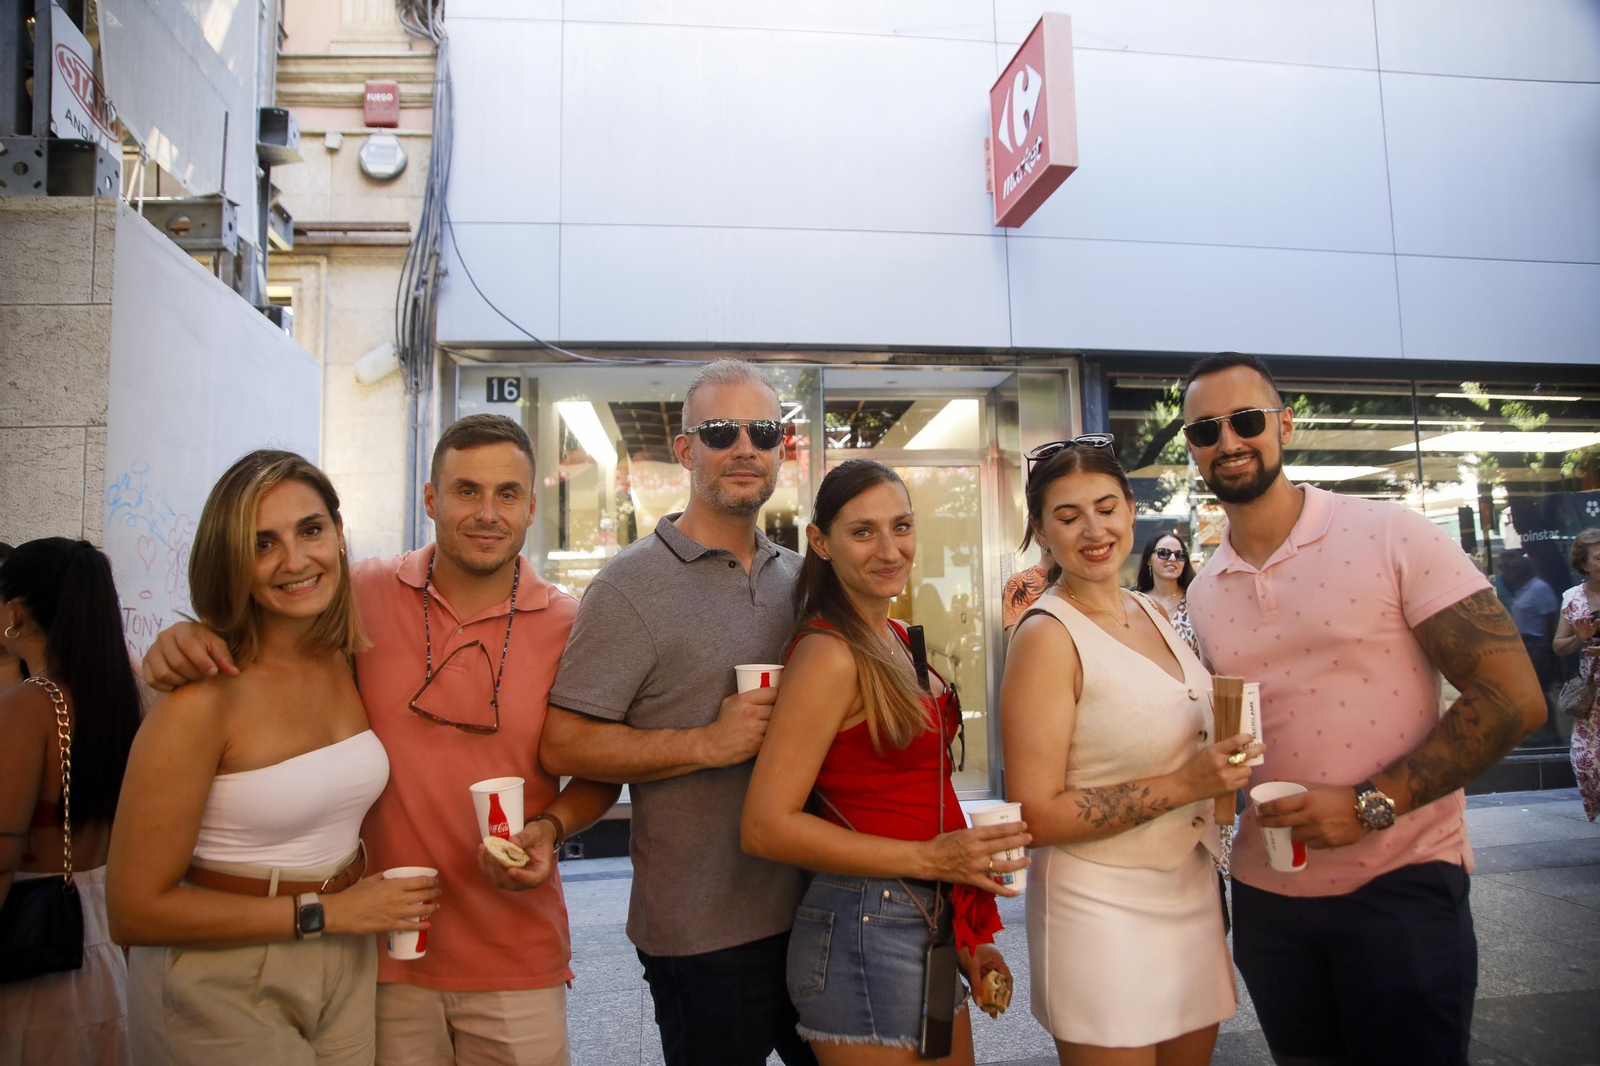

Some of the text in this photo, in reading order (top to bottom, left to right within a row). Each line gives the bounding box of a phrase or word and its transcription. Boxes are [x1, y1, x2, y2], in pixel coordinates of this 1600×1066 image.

[366, 92, 394, 102] FUEGO
[492, 378, 518, 400] 16
[122, 607, 163, 638] TONY
